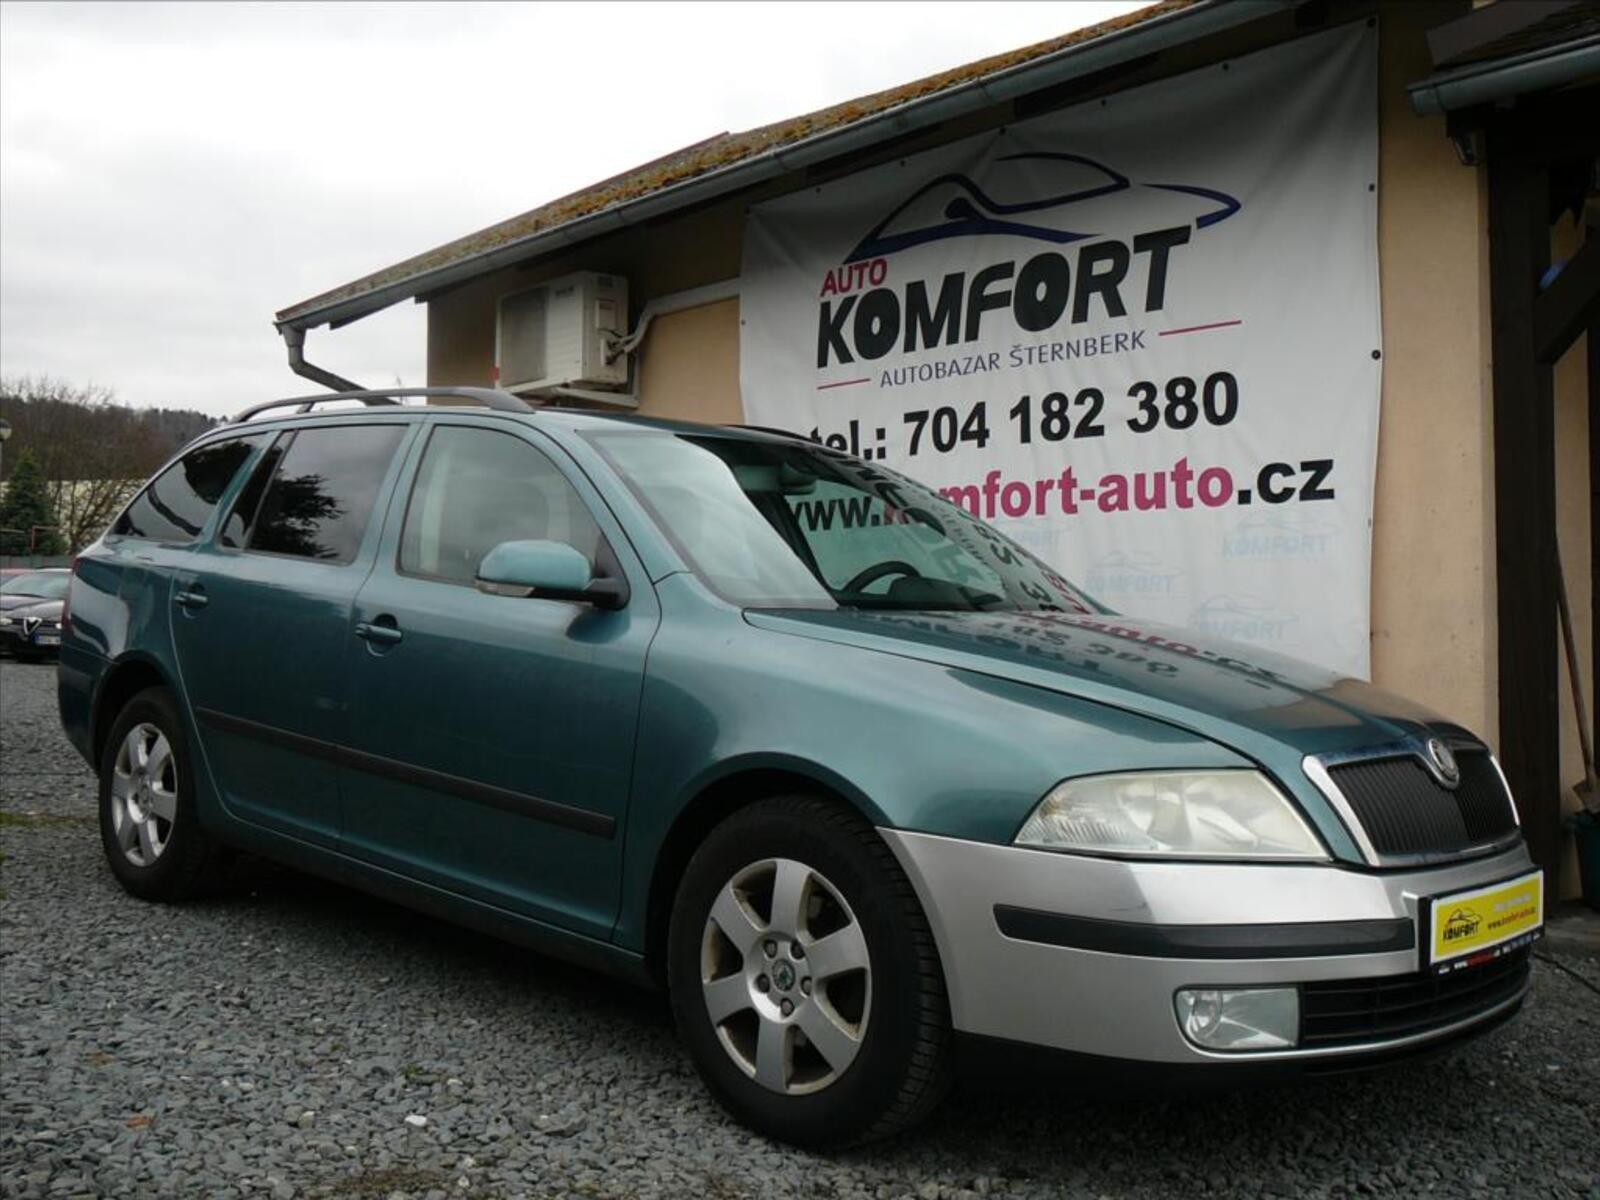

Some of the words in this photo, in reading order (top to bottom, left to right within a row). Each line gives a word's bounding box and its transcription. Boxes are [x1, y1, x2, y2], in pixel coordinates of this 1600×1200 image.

[816, 225, 1192, 369] KOMFORT
[820, 259, 887, 297] AUTO
[880, 352, 1001, 388] AUTOBAZAR
[1009, 329, 1146, 368] ŠTERNBERK
[903, 409, 991, 457] 704
[1009, 387, 1106, 445] 182
[1126, 371, 1240, 434] 380
